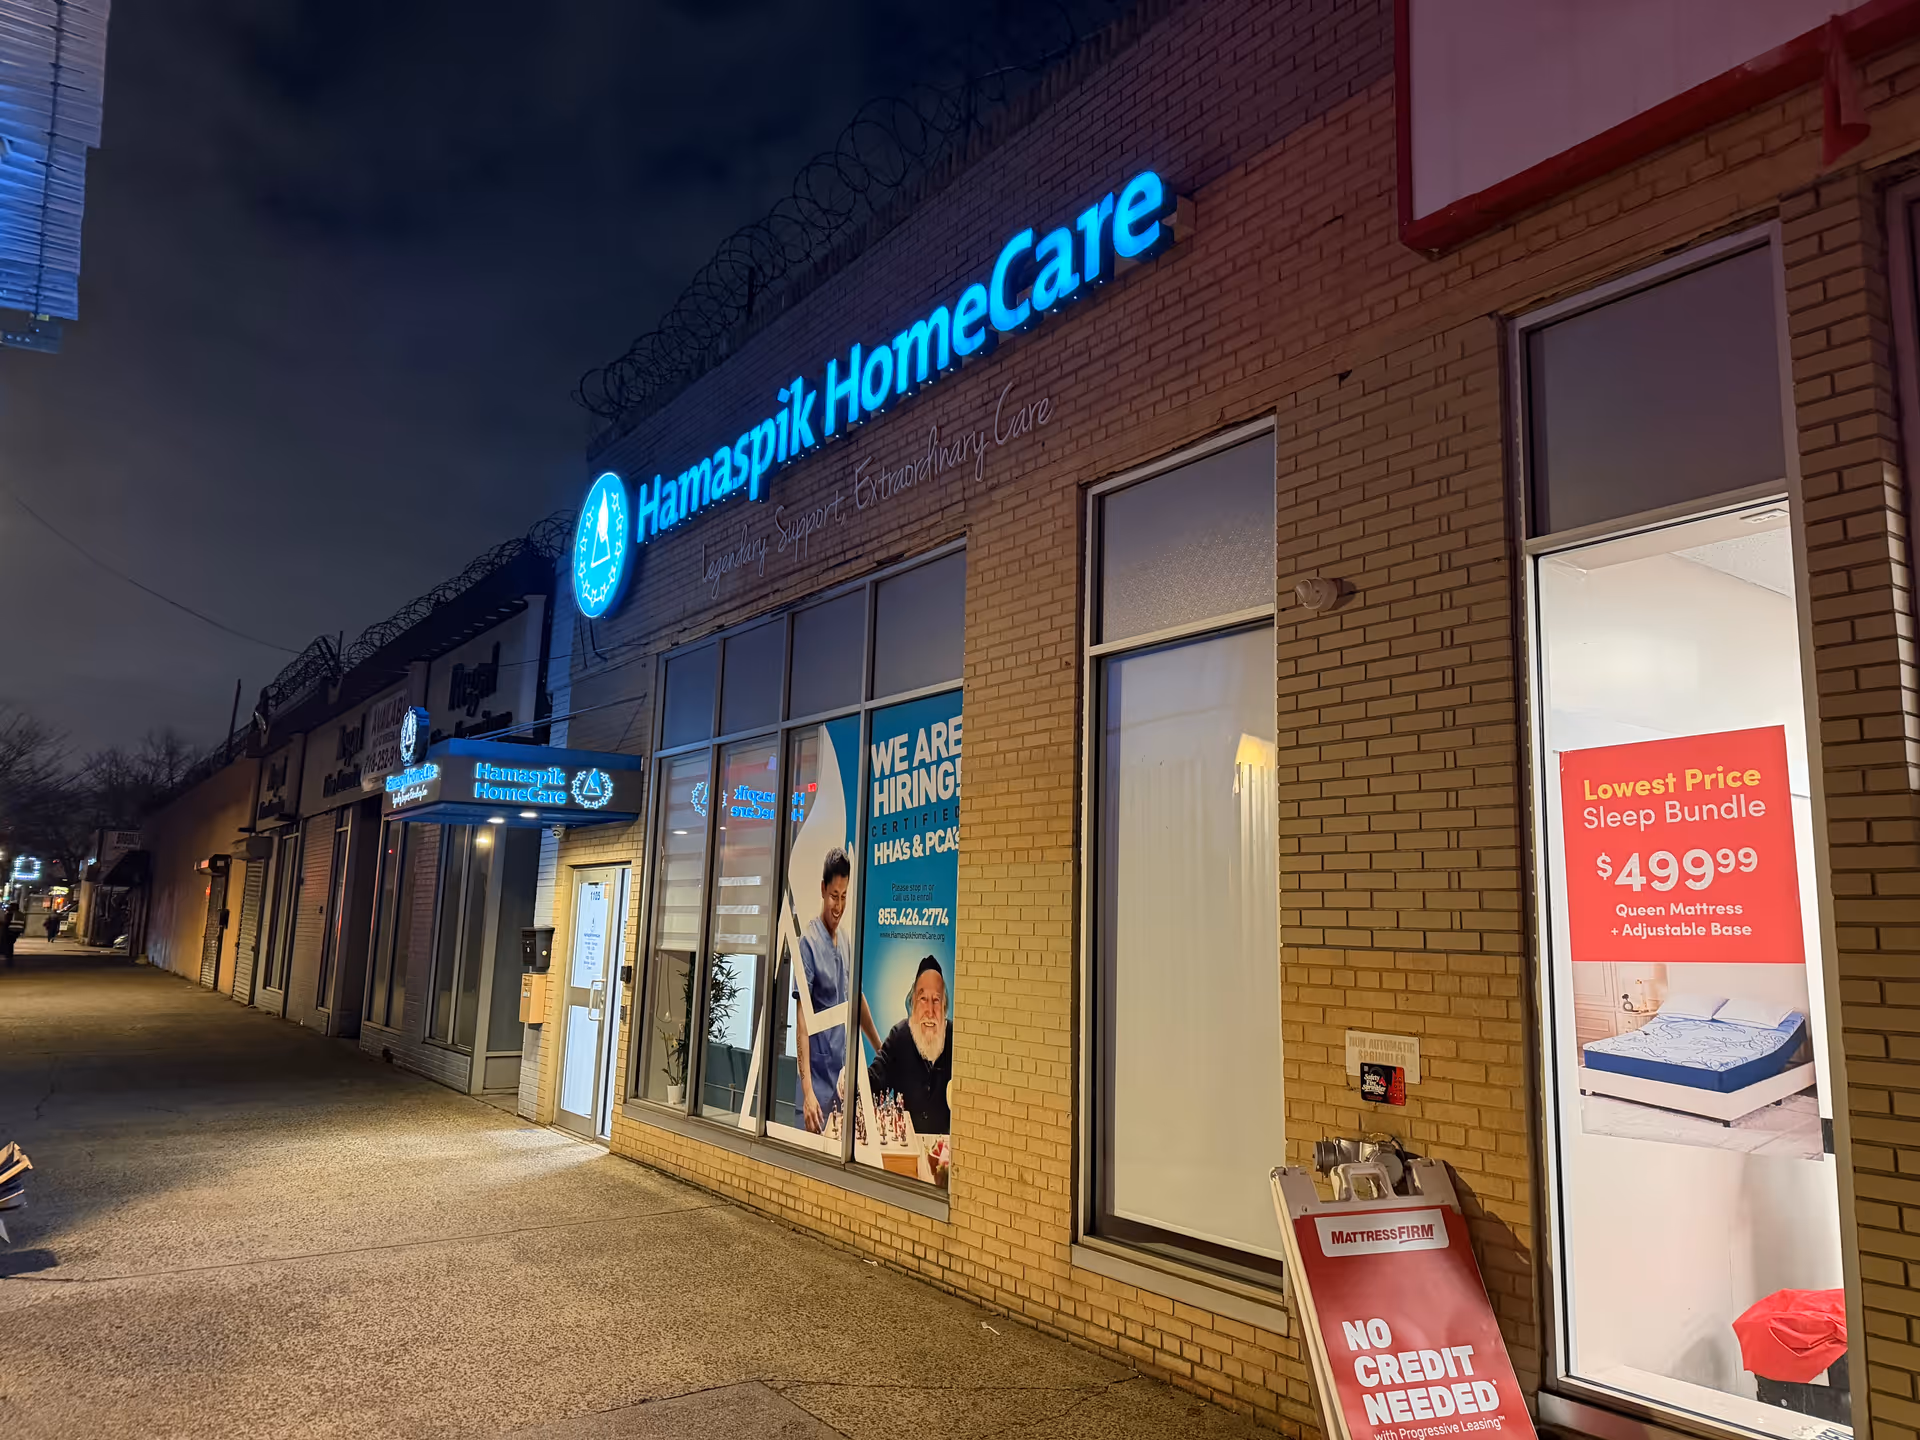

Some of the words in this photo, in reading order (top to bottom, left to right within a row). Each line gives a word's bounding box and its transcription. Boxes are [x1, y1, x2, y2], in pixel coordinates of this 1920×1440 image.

[637, 376, 817, 544] Hamaspik
[824, 170, 1162, 436] HomeCare
[702, 524, 769, 599] Legendary
[775, 490, 847, 563] Support,
[854, 425, 989, 509] Extraordinary
[994, 381, 1053, 445] Care
[871, 733, 909, 779] WE
[912, 715, 963, 767] ARE
[475, 763, 566, 787] Hamaspik
[1584, 773, 1676, 801] Lowest
[1685, 765, 1761, 791] Price
[473, 782, 568, 804] HomeCare
[873, 757, 962, 818] HIRING!
[1583, 806, 1656, 832] Sleep
[1665, 794, 1766, 823] Bundle
[874, 837, 911, 866] HHA's
[912, 834, 924, 858] &
[891, 883, 909, 892] Please
[910, 884, 921, 892] stop
[917, 893, 933, 901] enroll
[878, 908, 949, 926] 855.426.2774
[1616, 904, 1665, 918] Queen
[1670, 902, 1743, 915] Mattress
[1622, 922, 1706, 940] Adjustable
[1711, 922, 1752, 936] Base
[1358, 1050, 1407, 1066] SPRINKLER
[1368, 1039, 1415, 1054] AUTOMATIC
[1342, 1318, 1392, 1351] NO
[1354, 1345, 1474, 1388] CREDIT
[1374, 1428, 1398, 1440] with
[1400, 1423, 1460, 1440] Progressive
